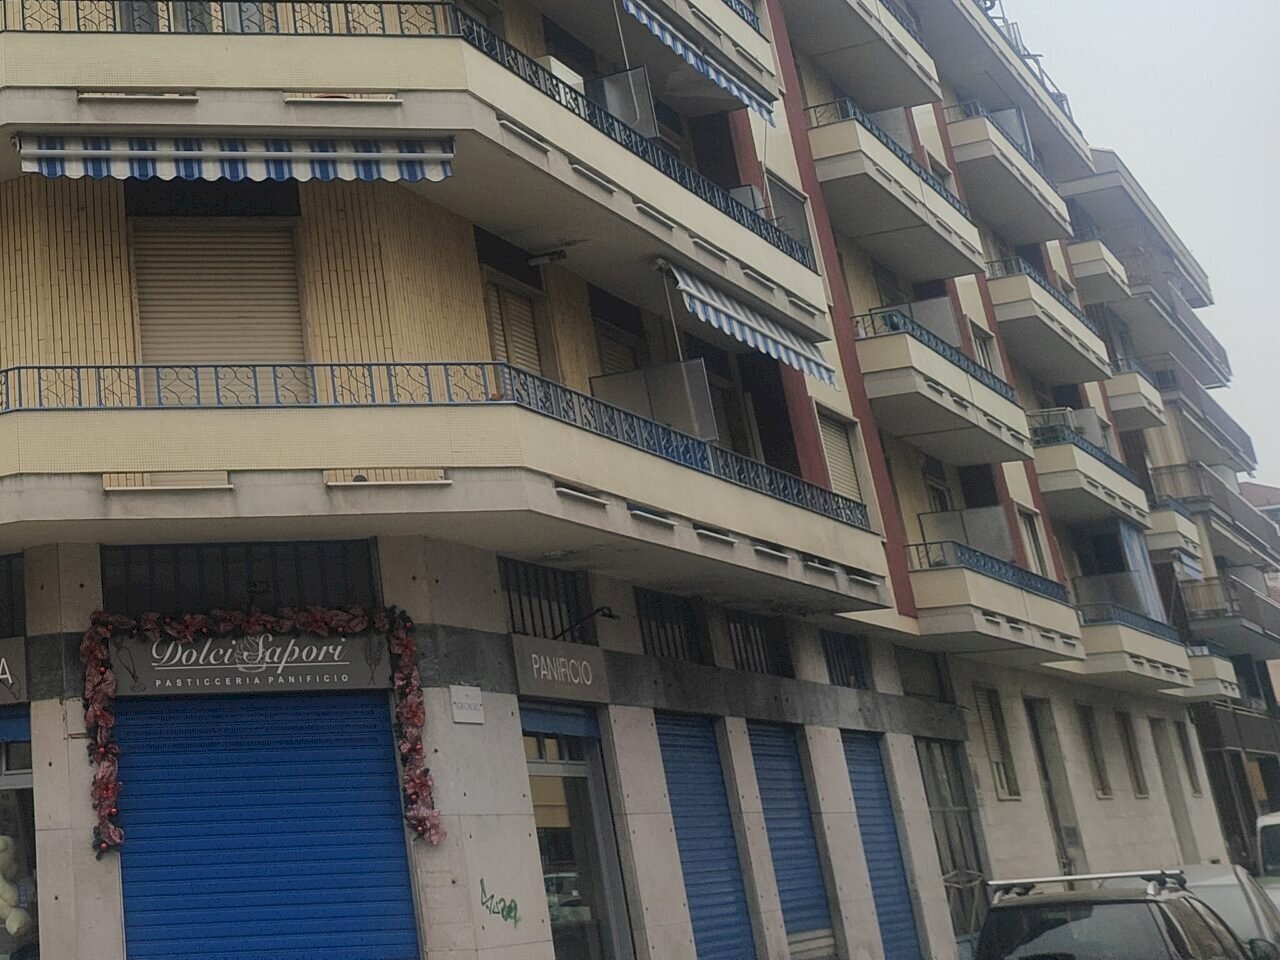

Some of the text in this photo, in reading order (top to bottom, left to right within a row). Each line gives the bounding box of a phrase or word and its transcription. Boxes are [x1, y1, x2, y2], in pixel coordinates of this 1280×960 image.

[151, 633, 347, 674] Dolci Sapori
[531, 653, 593, 686] PANIFICIO
[155, 673, 349, 687] PASTICCERIA PANIFICIO
